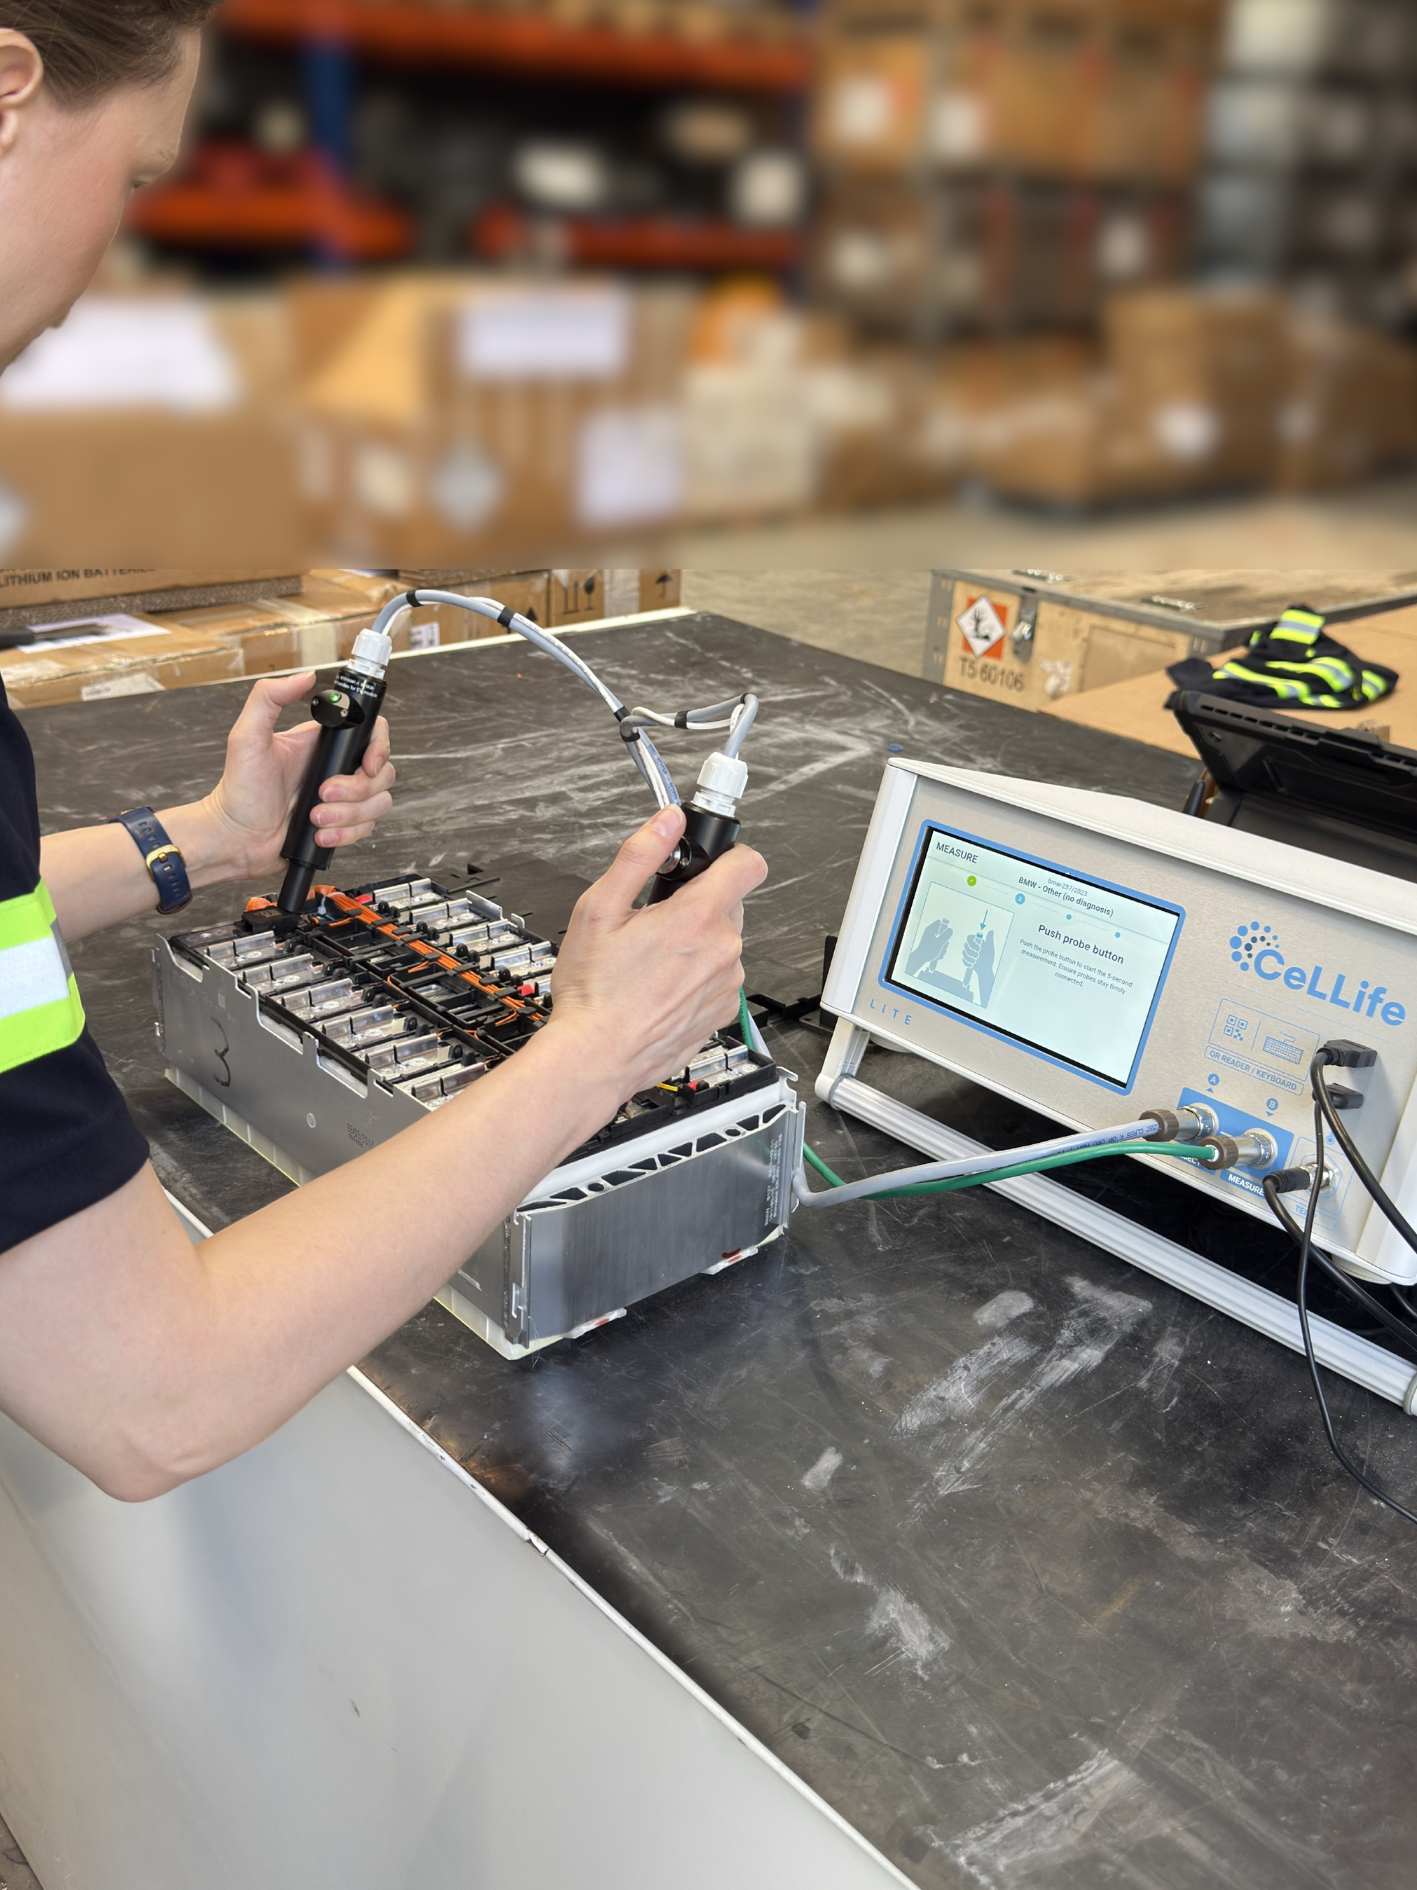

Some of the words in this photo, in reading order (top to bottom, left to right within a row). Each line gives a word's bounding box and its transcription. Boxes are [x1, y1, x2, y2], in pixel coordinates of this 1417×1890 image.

[0, 571, 53, 588] LITHIUM
[57, 569, 81, 581] ION
[979, 662, 1025, 693] 60106
[936, 841, 979, 865] MEASURE
[1018, 876, 1037, 889] BMW
[1042, 885, 1062, 898] Other
[1062, 892, 1075, 903] (no
[1076, 897, 1114, 918] diagnosis)
[1038, 924, 1062, 940] Push
[1062, 935, 1091, 951] probe
[1092, 944, 1124, 964] button
[1019, 938, 1033, 948] Push
[1033, 944, 1043, 952] the
[1042, 947, 1058, 958] probe
[1058, 953, 1076, 965] button
[1076, 960, 1083, 968] to
[1083, 963, 1097, 974] start
[1097, 969, 1106, 978] the
[1020, 949, 1057, 967] measurement.
[1058, 963, 1077, 975] Ensure
[1077, 969, 1096, 983] probes
[1096, 978, 1109, 989] stay
[1109, 981, 1126, 995] firmly
[1054, 972, 1084, 987] connected.
[1253, 948, 1406, 1027] CeLLife
[869, 998, 912, 1026] LITE
[1209, 1050, 1221, 1060] QR
[1221, 1054, 1251, 1072] READER
[1255, 1069, 1297, 1091] KEYBOARD
[1209, 1076, 1216, 1084] A
[1268, 1100, 1276, 1108] B
[1108, 1135, 1117, 1143] OR
[1126, 1127, 1144, 1139] CLASS
[1180, 1153, 1201, 1167] JECT
[1228, 1173, 1264, 1196] MEASURE
